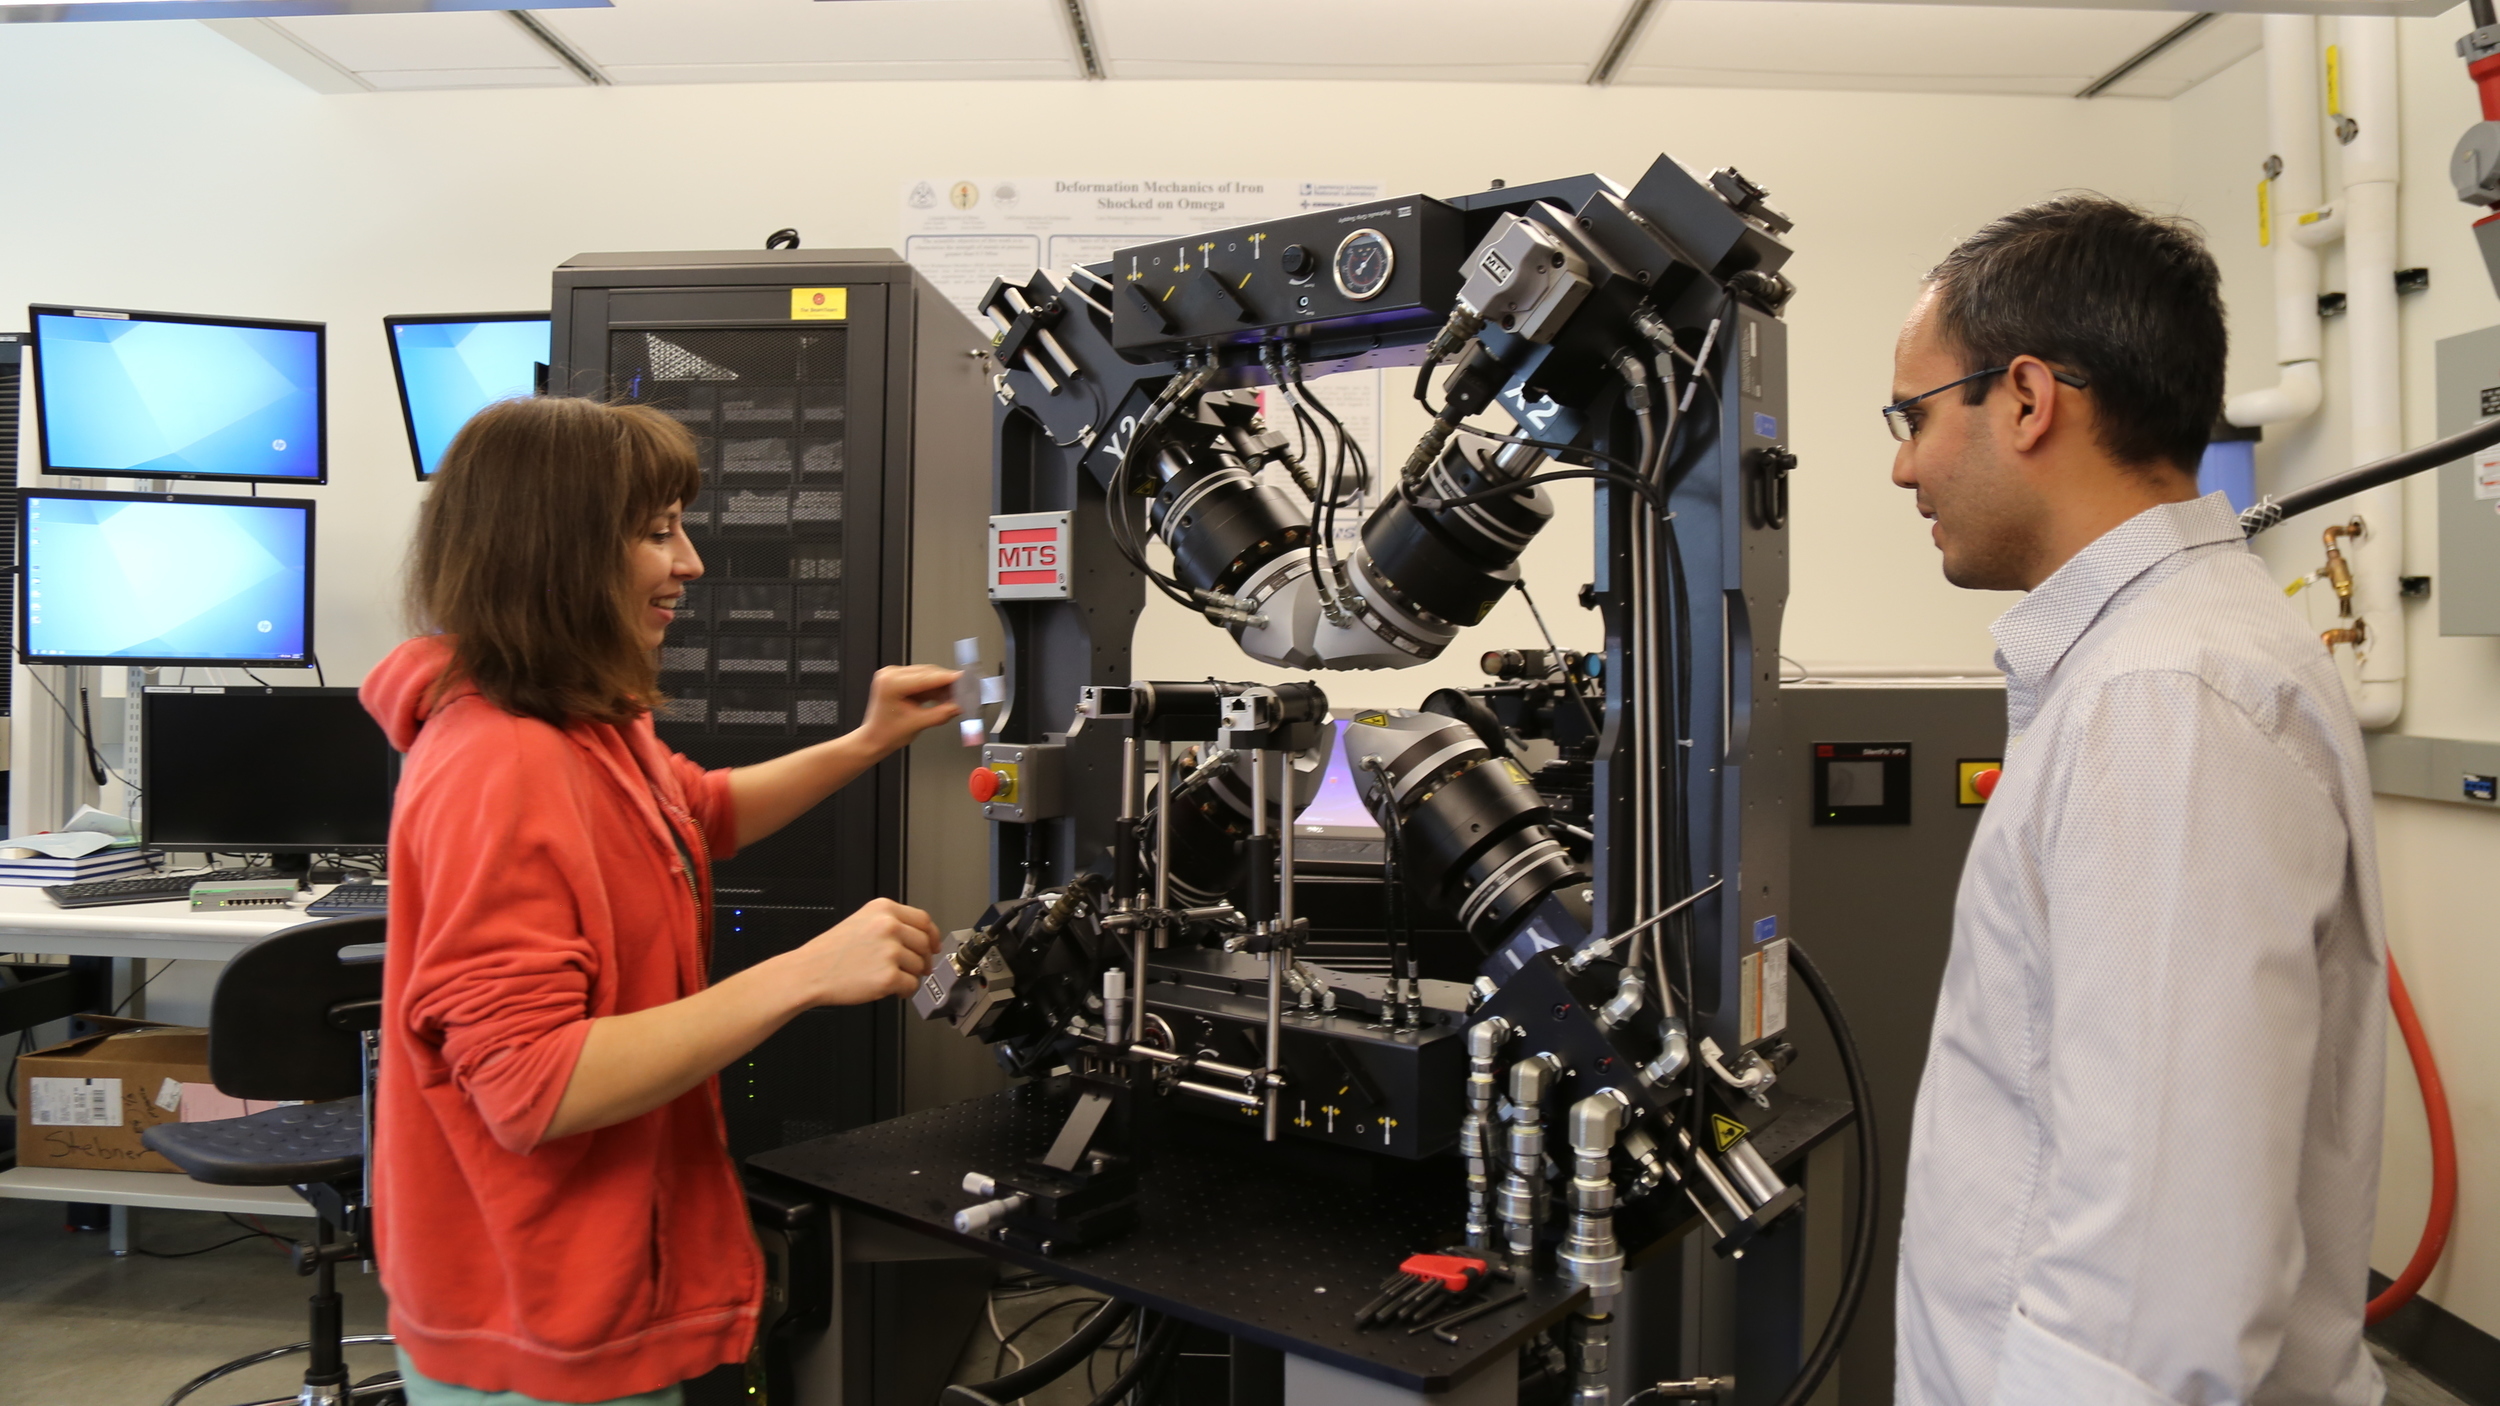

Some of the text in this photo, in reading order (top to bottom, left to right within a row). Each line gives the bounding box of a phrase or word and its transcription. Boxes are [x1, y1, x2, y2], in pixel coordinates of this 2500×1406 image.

[1055, 181, 1264, 194] Deformation Mechanics of Iron
[1097, 198, 1225, 212] Shocked on Omega
[1486, 255, 1509, 281] MTS
[1102, 415, 1136, 460] Y2
[998, 545, 1057, 568] MTS
[44, 1130, 158, 1160] Stebner
